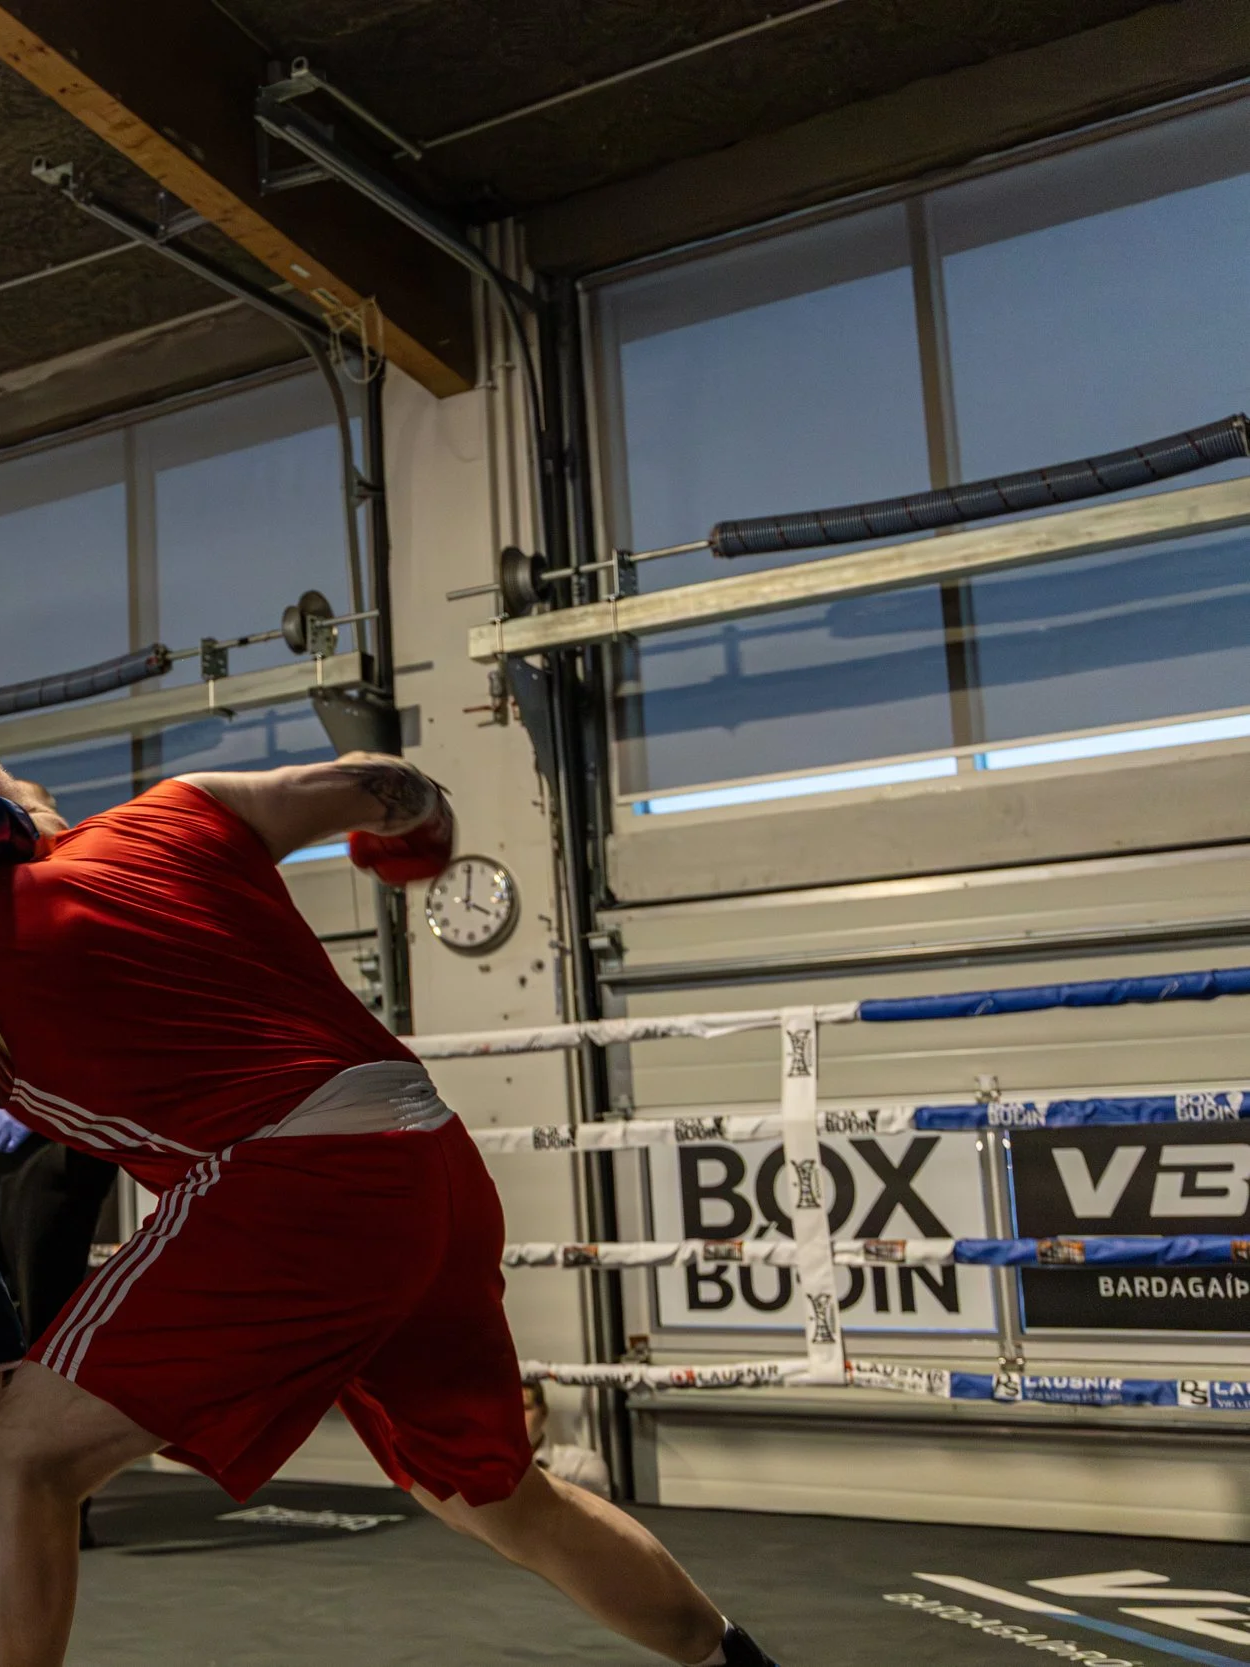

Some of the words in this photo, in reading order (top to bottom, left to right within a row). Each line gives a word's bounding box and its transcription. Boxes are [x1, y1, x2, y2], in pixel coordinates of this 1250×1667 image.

[678, 1136, 954, 1240] BOX
[1024, 1376, 1123, 1390] LAUSNIR
[1214, 1382, 1250, 1395] LA
